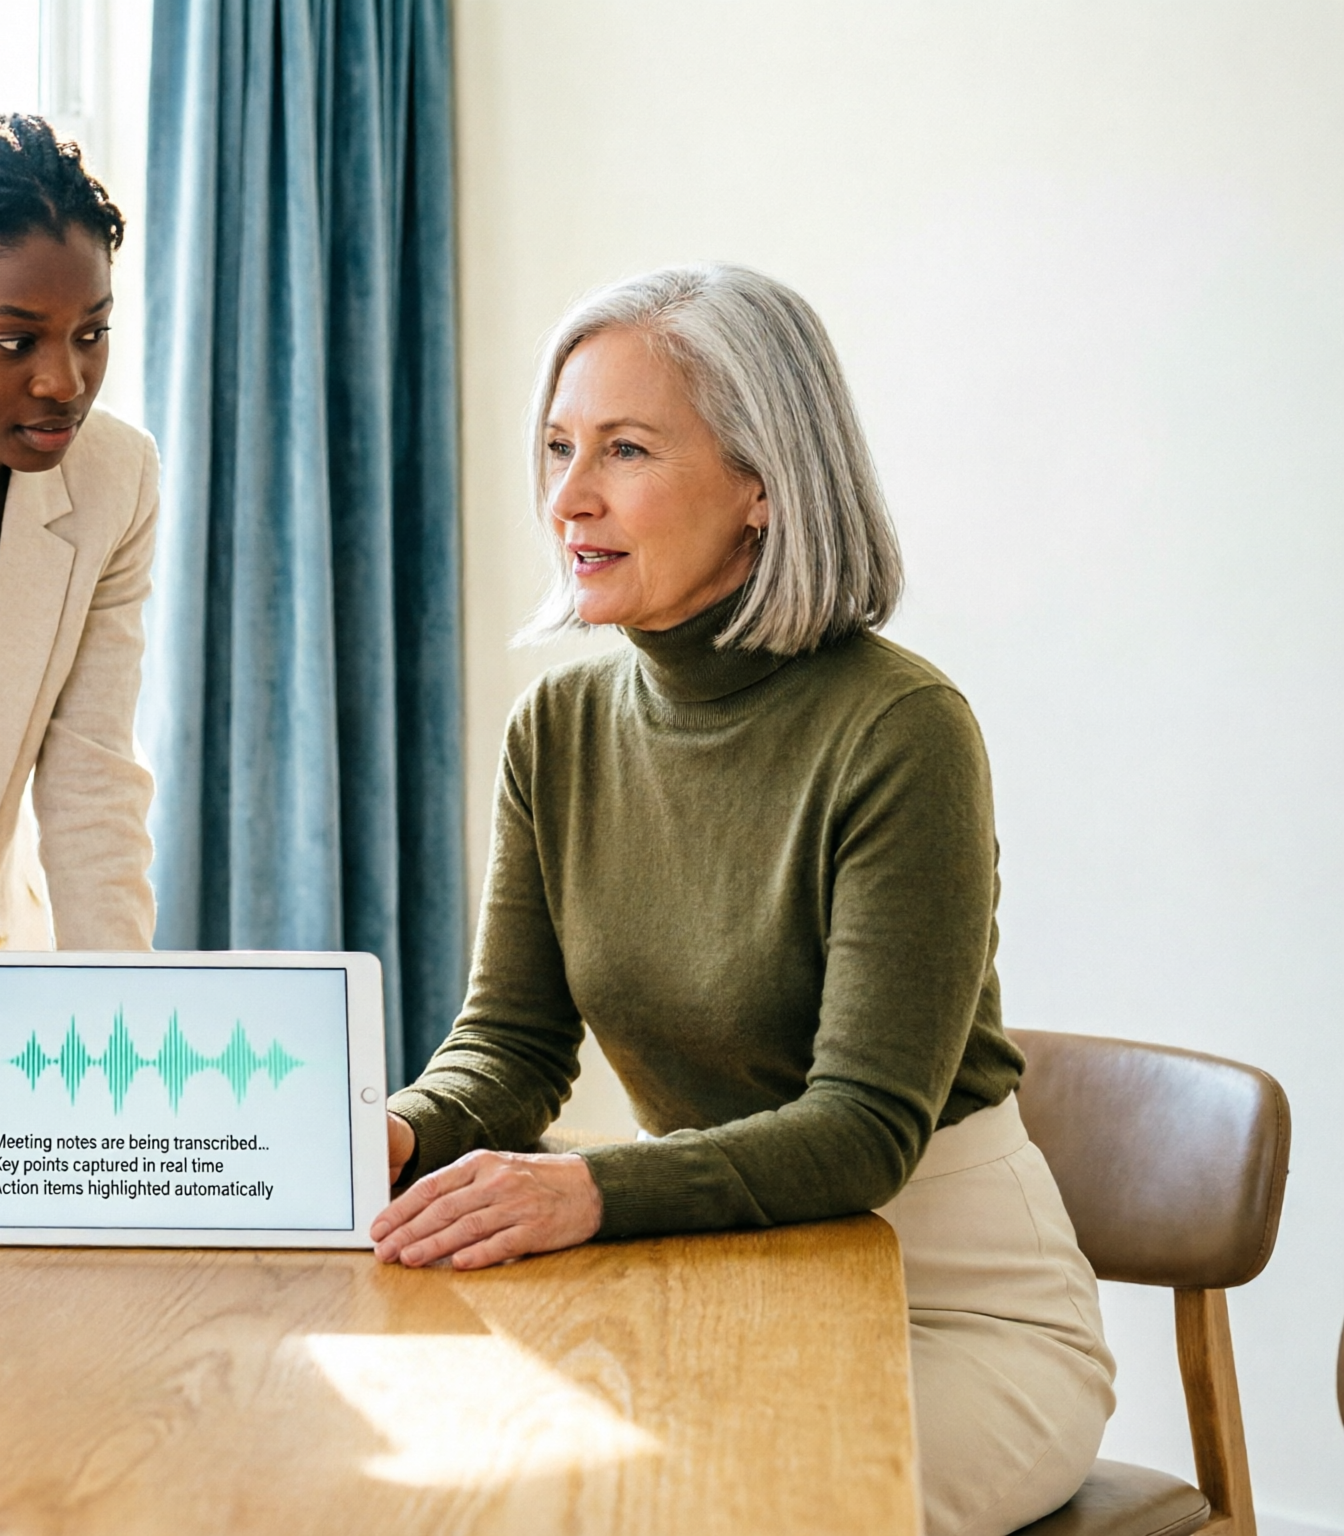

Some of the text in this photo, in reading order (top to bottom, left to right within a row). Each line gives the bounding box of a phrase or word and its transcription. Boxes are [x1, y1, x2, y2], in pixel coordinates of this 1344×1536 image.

[57, 1136, 97, 1149] notes
[102, 1138, 124, 1149] are
[129, 1134, 169, 1153] being
[174, 1135, 269, 1150] transcribed...
[24, 1156, 68, 1175] points
[73, 1157, 138, 1176] captured
[143, 1157, 155, 1172] in
[161, 1157, 187, 1172] real
[192, 1158, 223, 1173] time
[44, 1180, 83, 1195] items
[89, 1180, 170, 1199] highlighted
[175, 1181, 273, 1200] automatically
